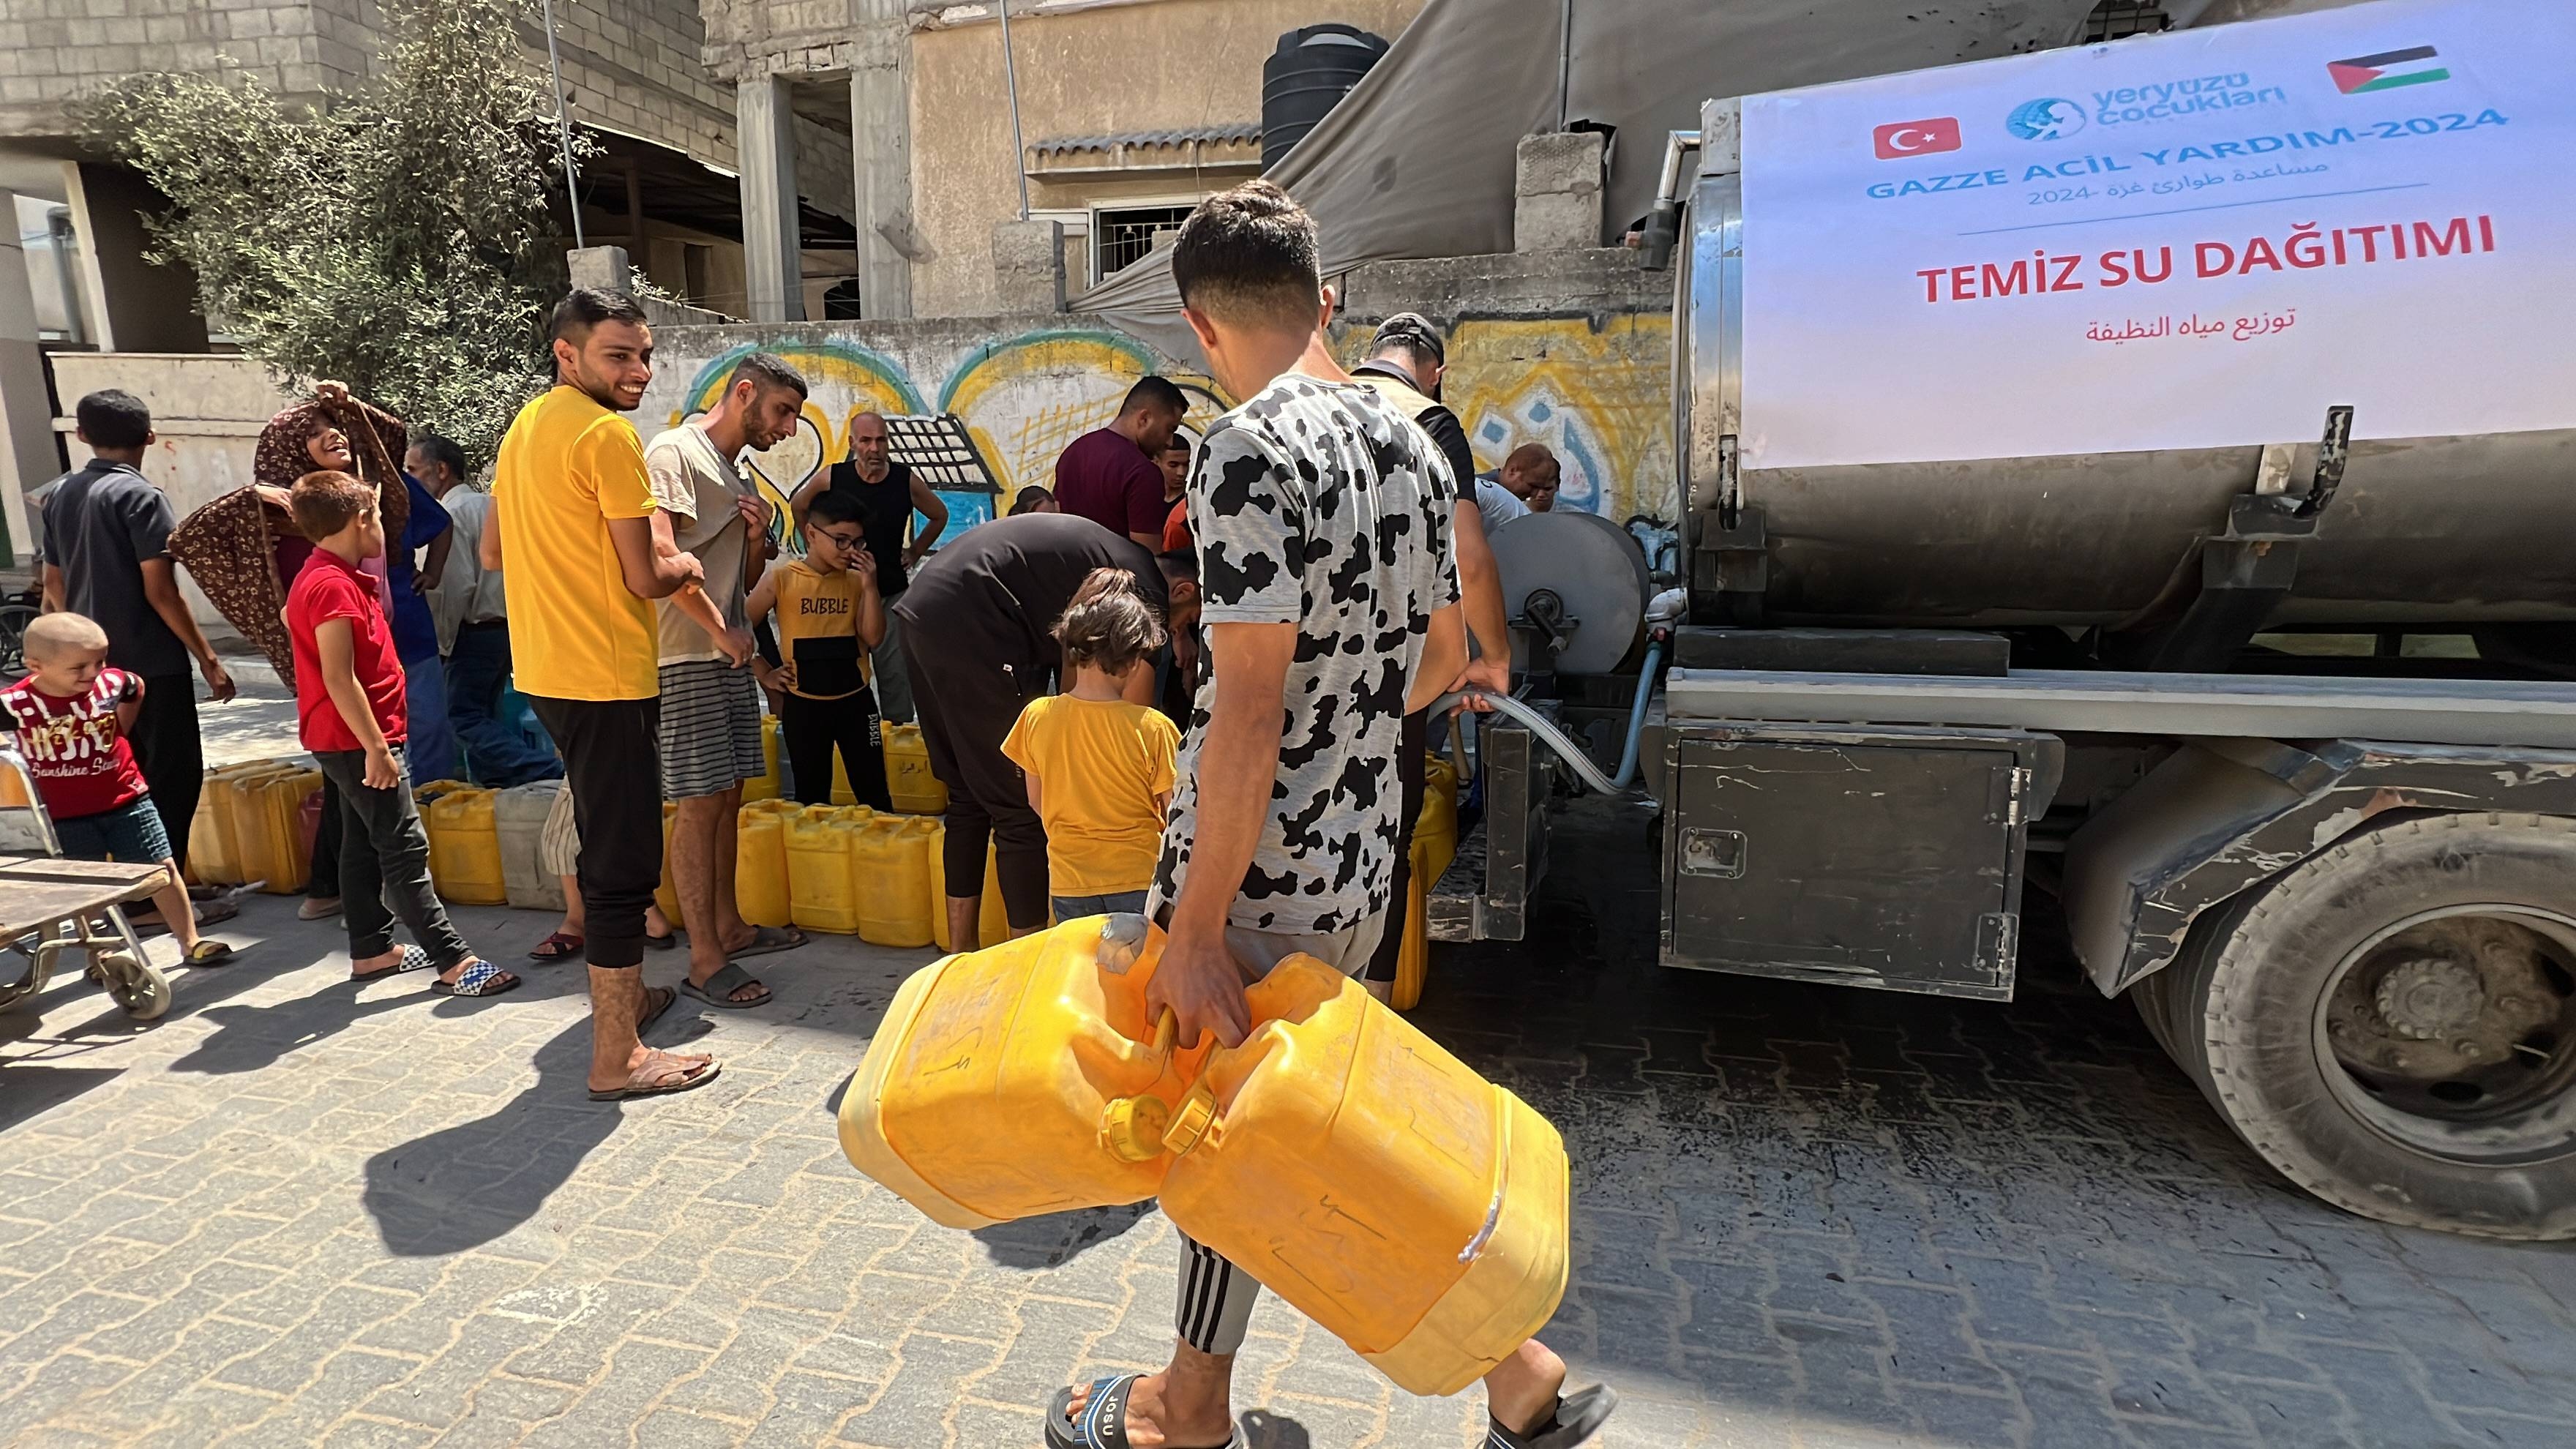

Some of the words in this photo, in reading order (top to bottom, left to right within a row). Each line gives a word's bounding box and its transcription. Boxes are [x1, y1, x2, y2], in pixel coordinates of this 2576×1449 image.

[1866, 169, 2009, 199] GAZZE
[2141, 108, 2509, 165] YARDIM-2024
[2152, 175, 2224, 195] طوارئ
[2233, 162, 2328, 181] مساعدة
[2108, 181, 2144, 198] غزة
[1916, 250, 2083, 303] TEMİZ
[2099, 246, 2172, 287] SU
[2195, 215, 2495, 278] DAĞITIMI
[2086, 315, 2170, 345] النظيفة
[2179, 313, 2225, 339] مياه
[2233, 308, 2296, 341] توزيع
[801, 598, 849, 615] BUBBLE
[1103, 1396, 1118, 1436] JOSU
